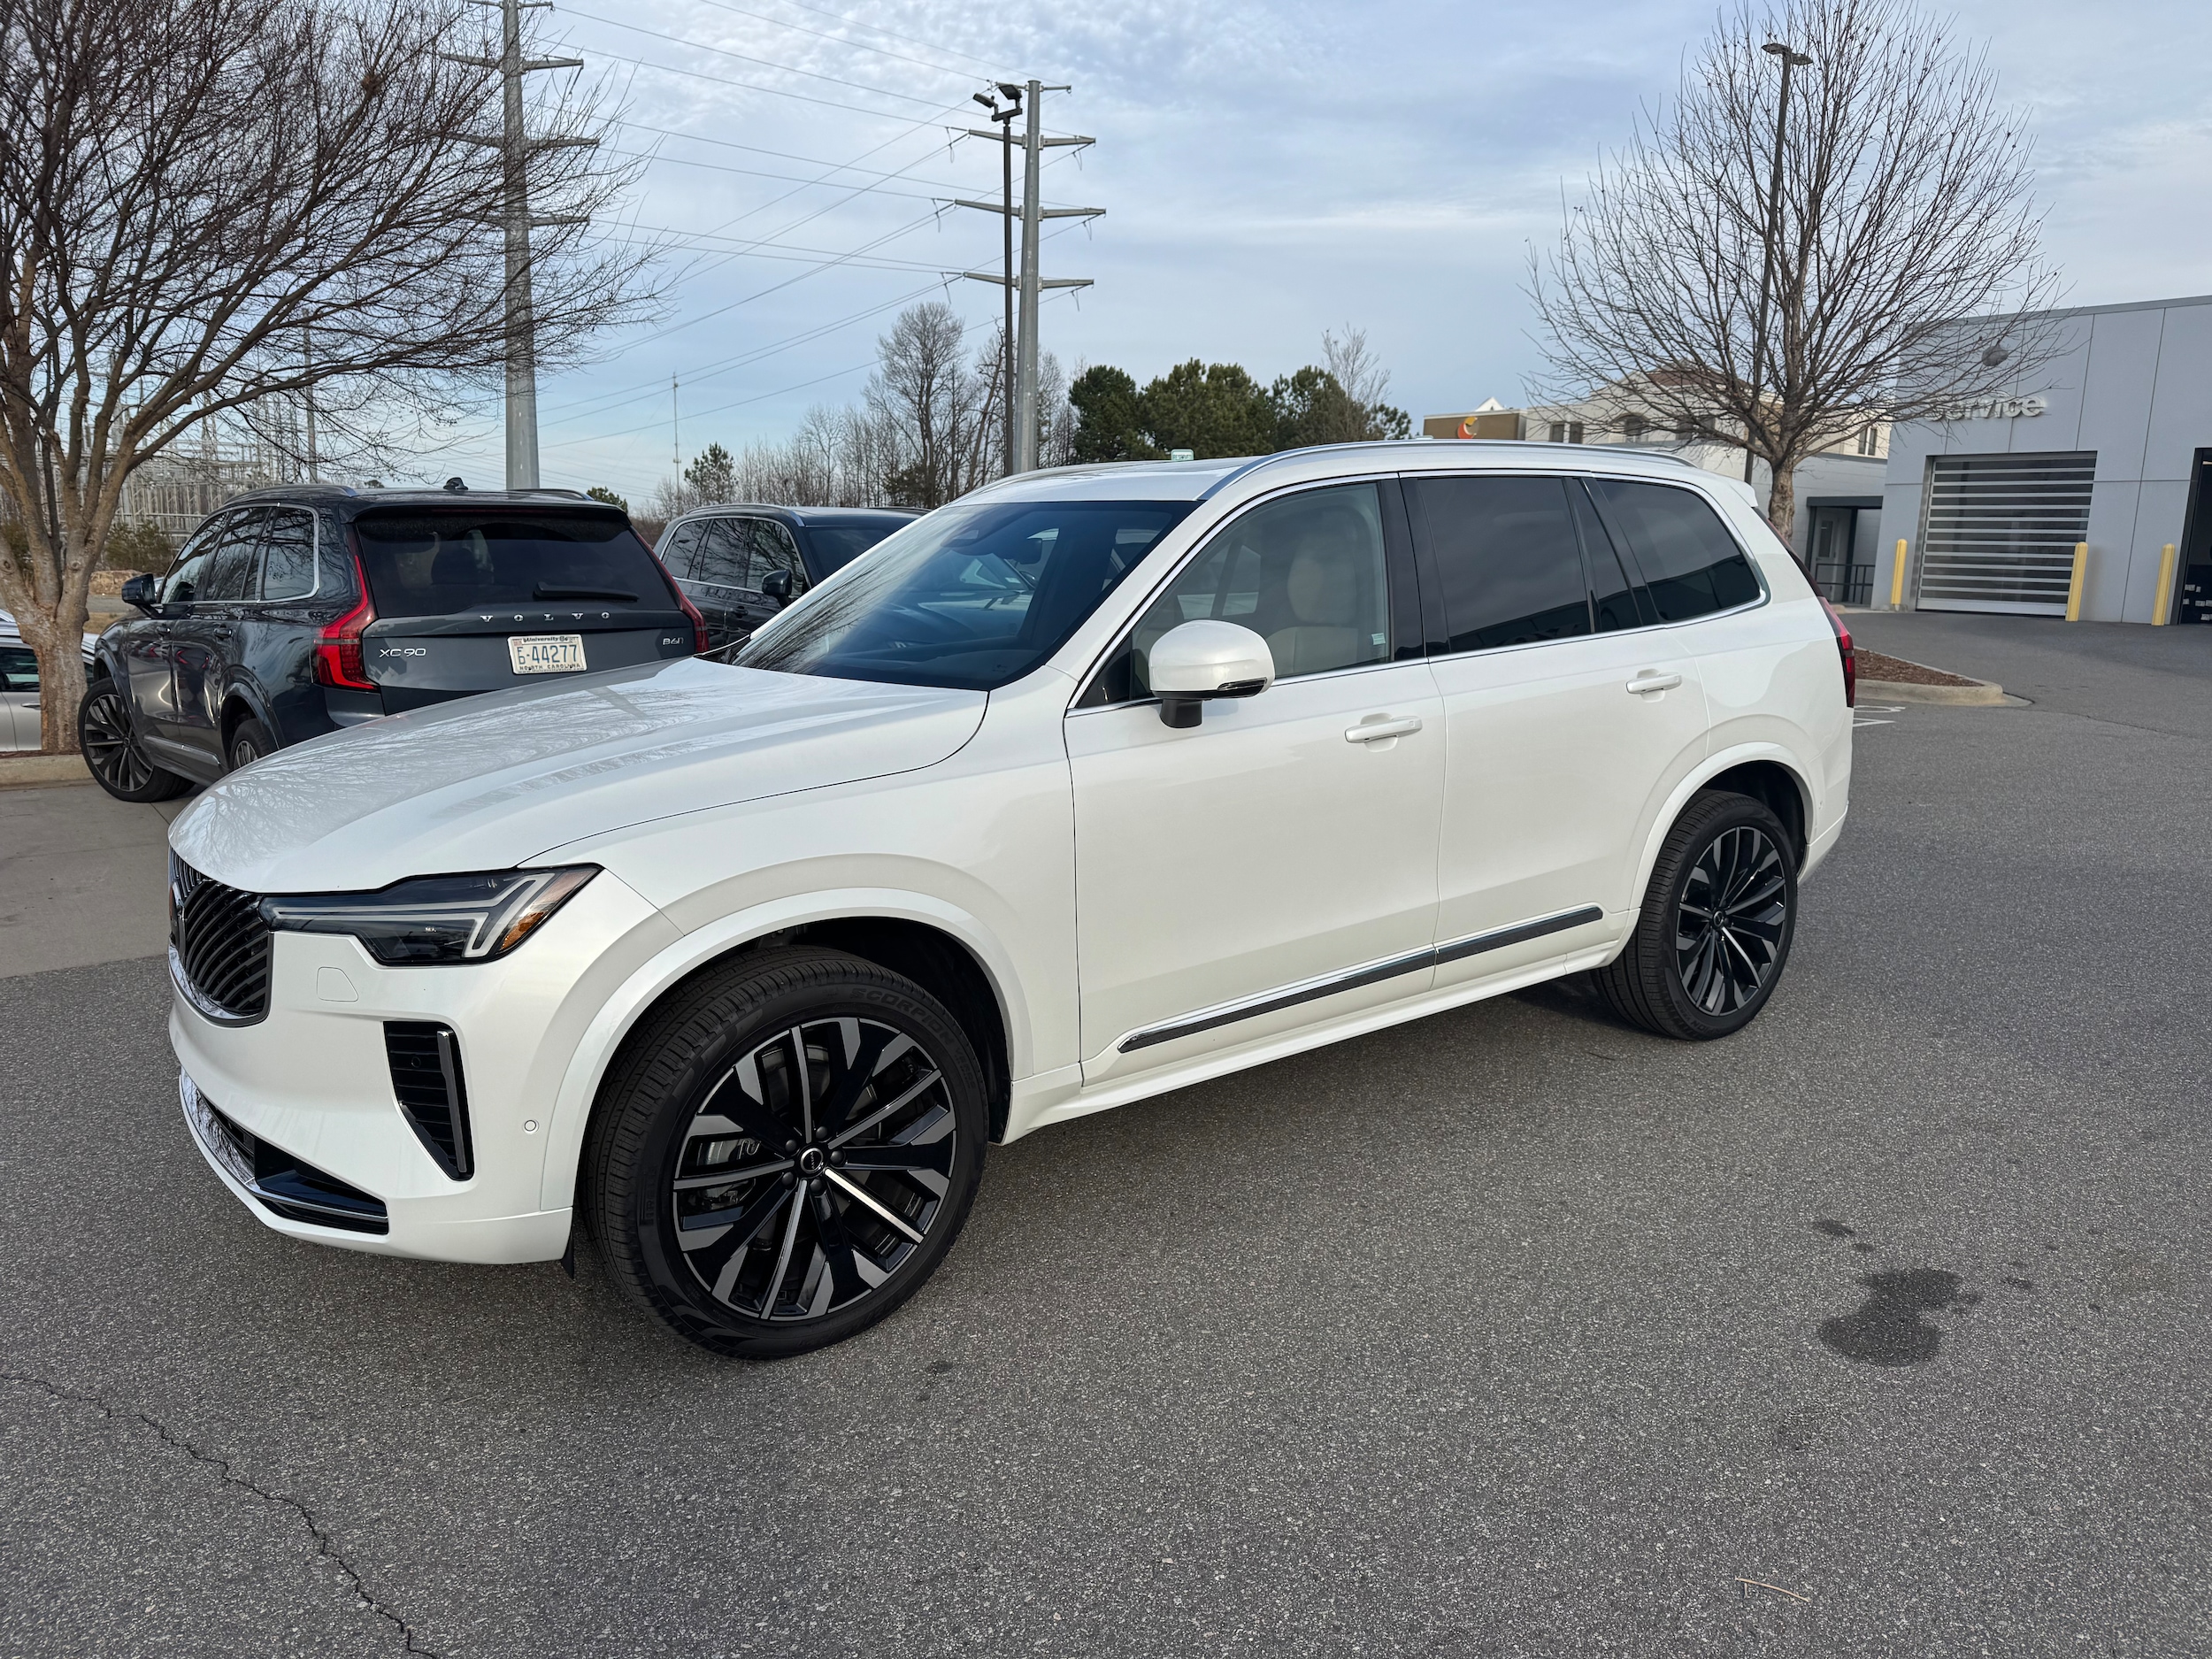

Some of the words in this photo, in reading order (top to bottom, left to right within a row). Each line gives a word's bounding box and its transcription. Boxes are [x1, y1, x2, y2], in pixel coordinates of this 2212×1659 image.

[480, 611, 611, 623] VOLVO
[379, 648, 426, 658] XC90
[849, 987, 955, 1045] SCORPION
